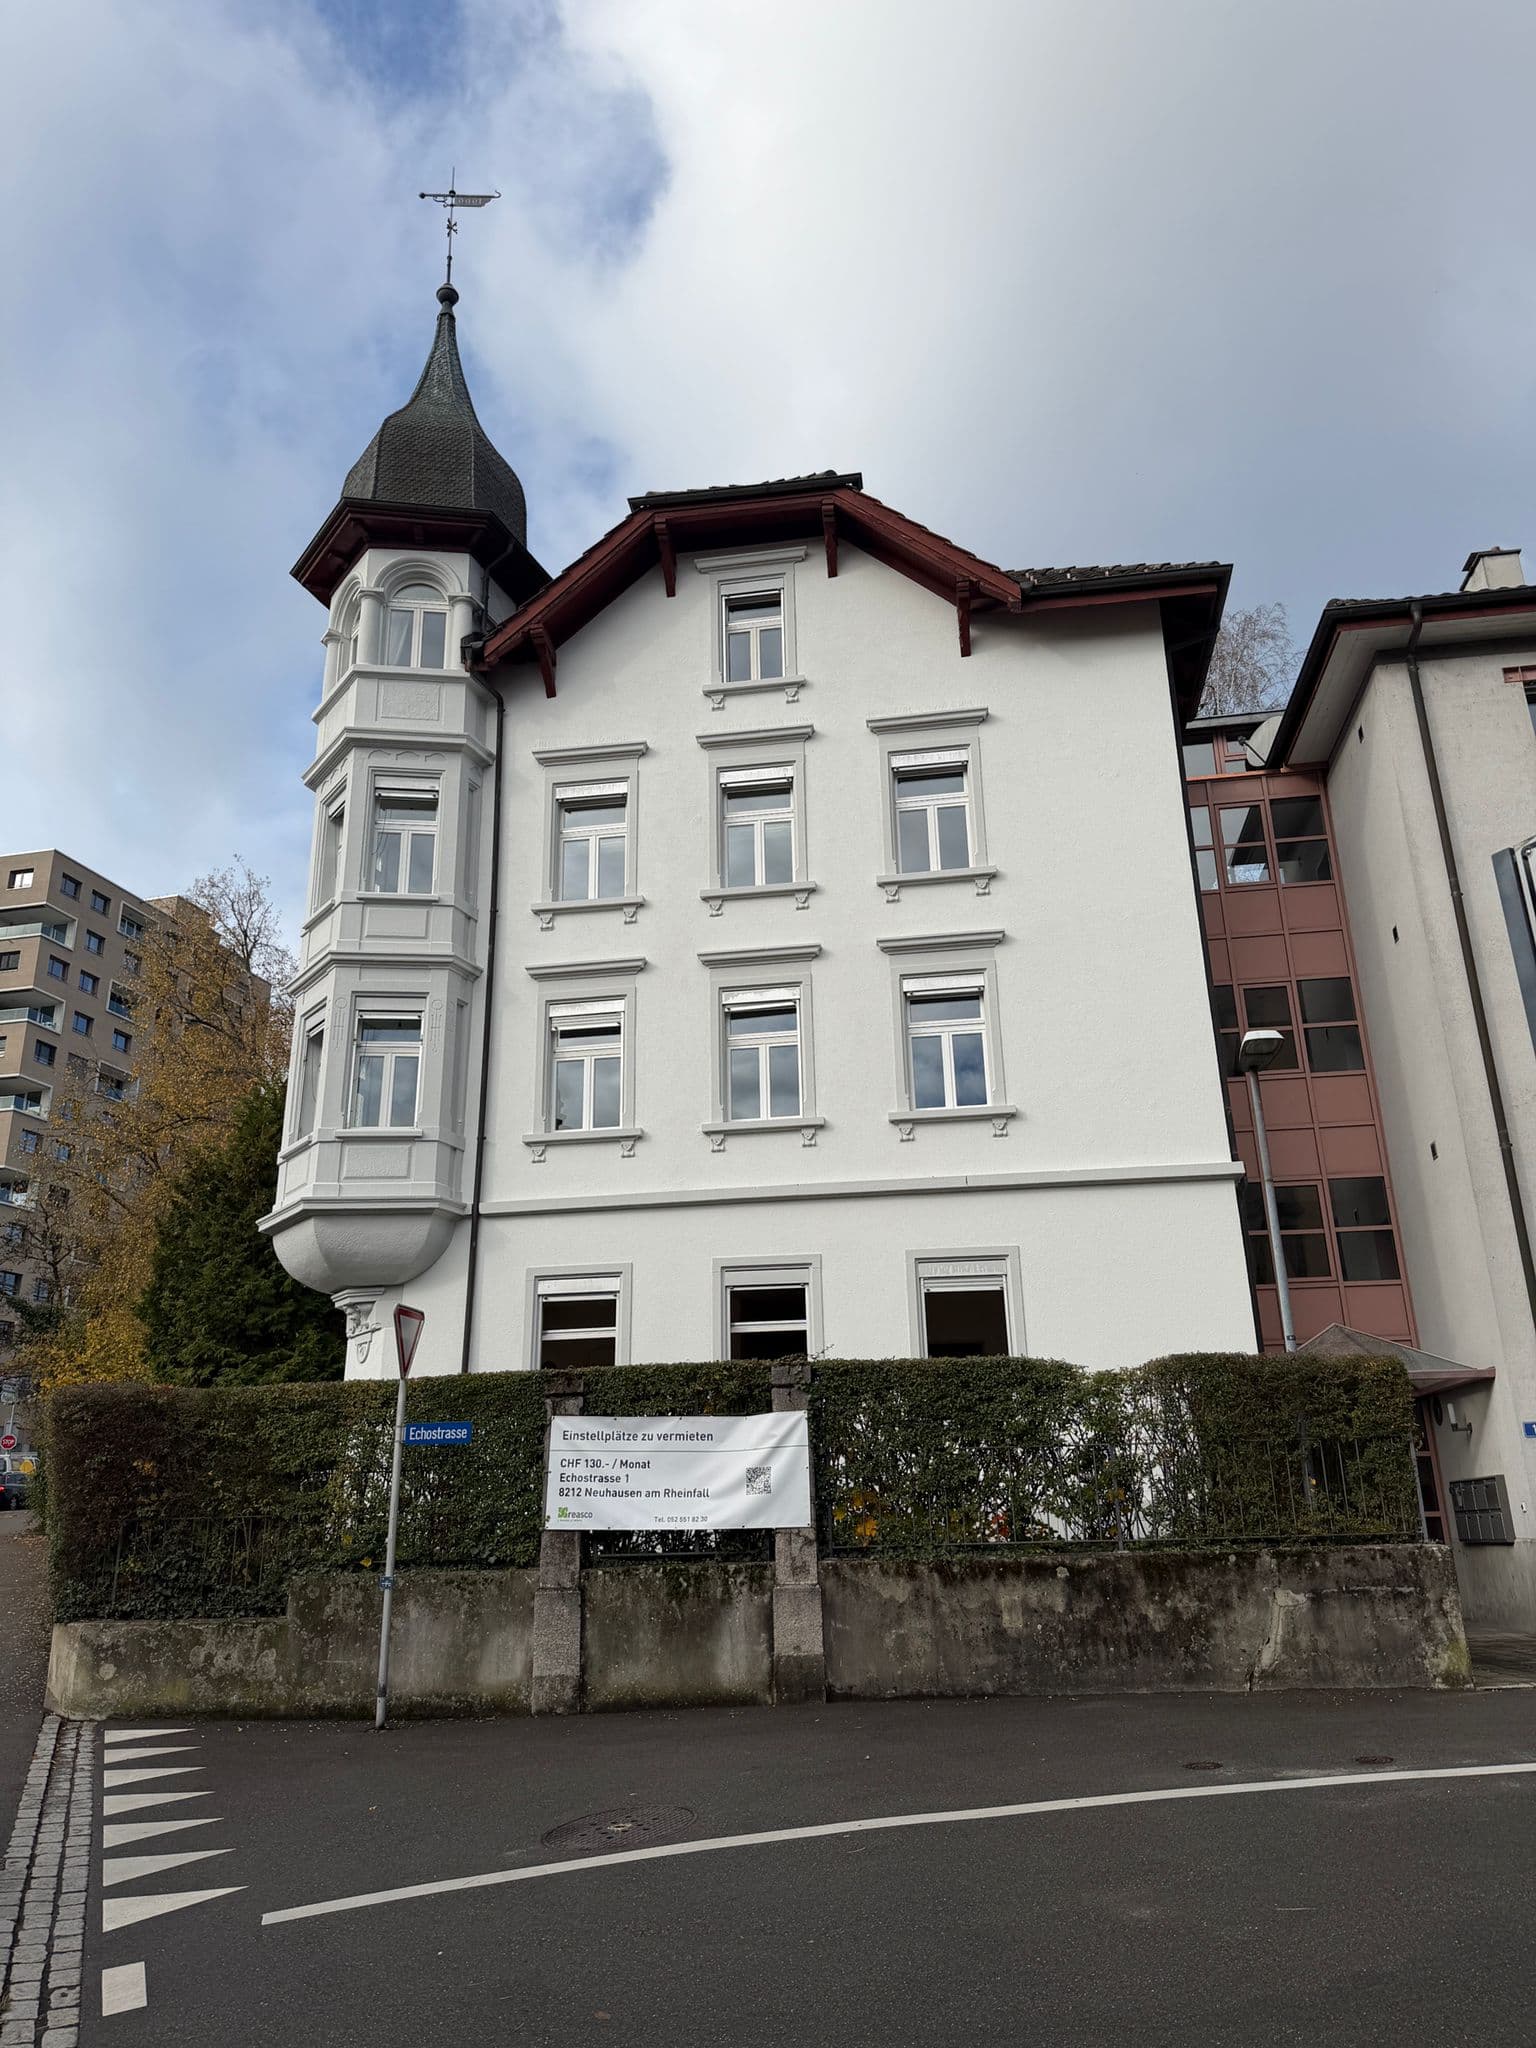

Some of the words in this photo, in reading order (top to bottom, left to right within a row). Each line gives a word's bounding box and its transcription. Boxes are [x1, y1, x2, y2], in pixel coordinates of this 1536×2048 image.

[409, 1426, 468, 1440] Echostrasse
[562, 1430, 638, 1443] Einstellplätze
[641, 1433, 654, 1441] zu
[656, 1431, 714, 1441] vermieten
[560, 1458, 582, 1468] CHF
[584, 1458, 609, 1469] 130.-
[612, 1458, 618, 1469] /
[619, 1459, 651, 1469] Monat
[559, 1473, 622, 1483] Echostrasse
[625, 1473, 630, 1483] 1
[558, 1487, 582, 1497] 8212
[584, 1487, 642, 1498] Neuhausen
[644, 1490, 660, 1498] am
[663, 1488, 710, 1498] Rheinfall
